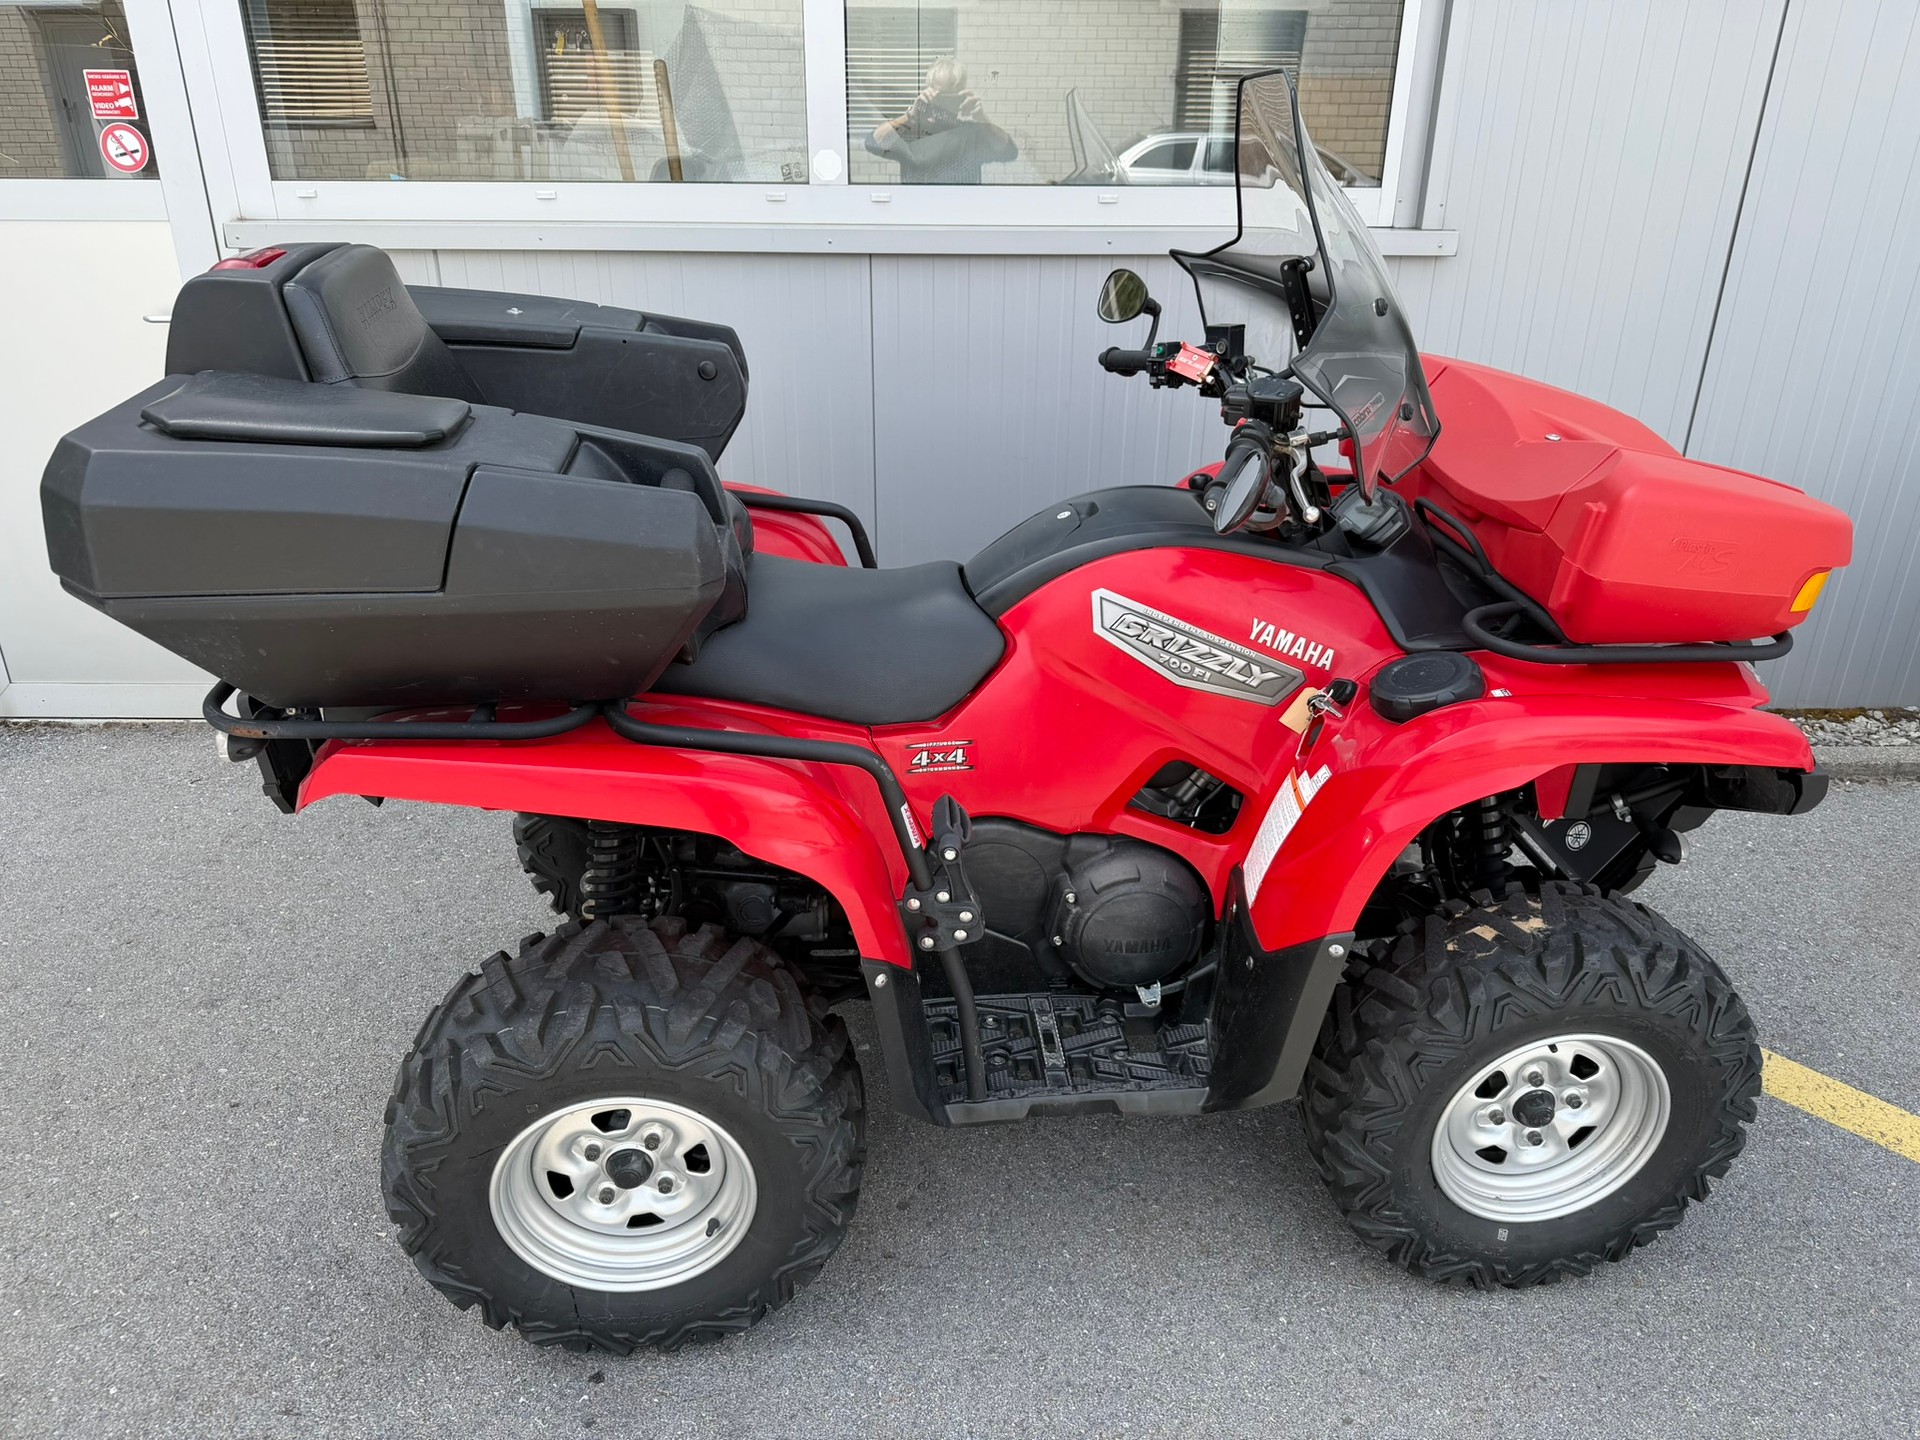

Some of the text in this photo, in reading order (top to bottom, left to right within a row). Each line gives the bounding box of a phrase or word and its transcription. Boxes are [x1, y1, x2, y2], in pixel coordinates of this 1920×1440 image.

[1109, 612, 1284, 689] GRIZZLY
[1143, 608, 1257, 659] INDEPENDENT SUSPENSION
[1249, 617, 1336, 671] YAMAHA
[1159, 653, 1192, 674] 700
[911, 748, 966, 767] 4x4
[1103, 937, 1171, 954] YAMAHA
